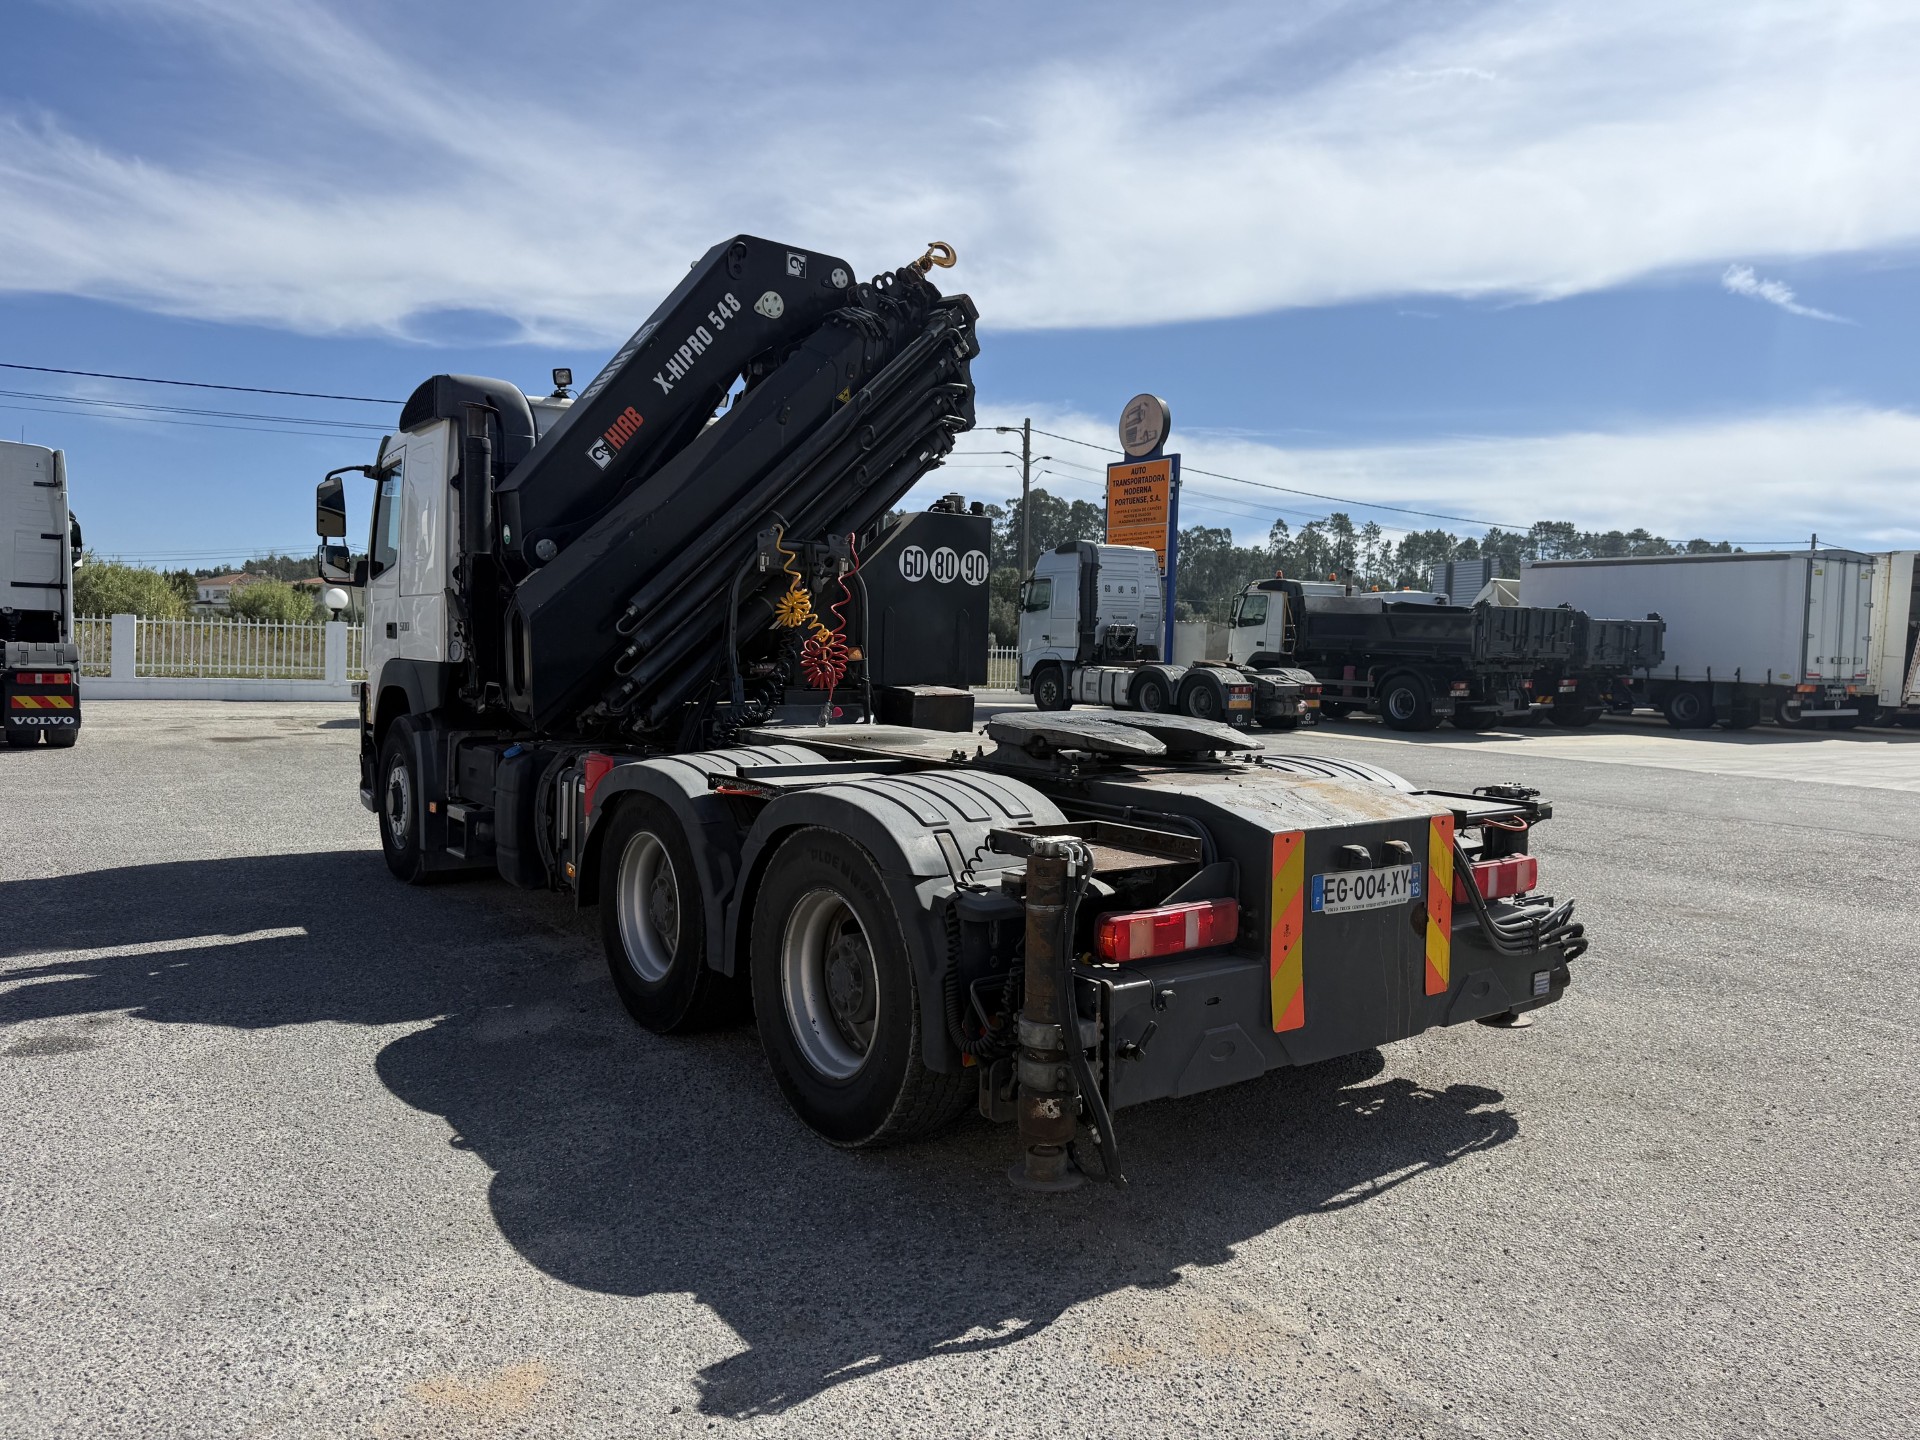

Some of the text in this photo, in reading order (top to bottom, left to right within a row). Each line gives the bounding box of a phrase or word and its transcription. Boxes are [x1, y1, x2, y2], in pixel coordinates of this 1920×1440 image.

[653, 292, 741, 395] X-HIPRO 548
[603, 406, 644, 450] HIAB
[1112, 474, 1165, 487] TRANSPORTADORA
[1131, 466, 1147, 475] AUTO
[1114, 495, 1149, 506] PORTUENSE,
[1123, 485, 1152, 495] MODERNA
[903, 550, 923, 577] 60
[935, 551, 954, 579] 80
[965, 553, 984, 581] 90
[10, 716, 75, 725] VOLVO
[1324, 869, 1409, 904] EG-004-XY
[1412, 882, 1419, 895] 13
